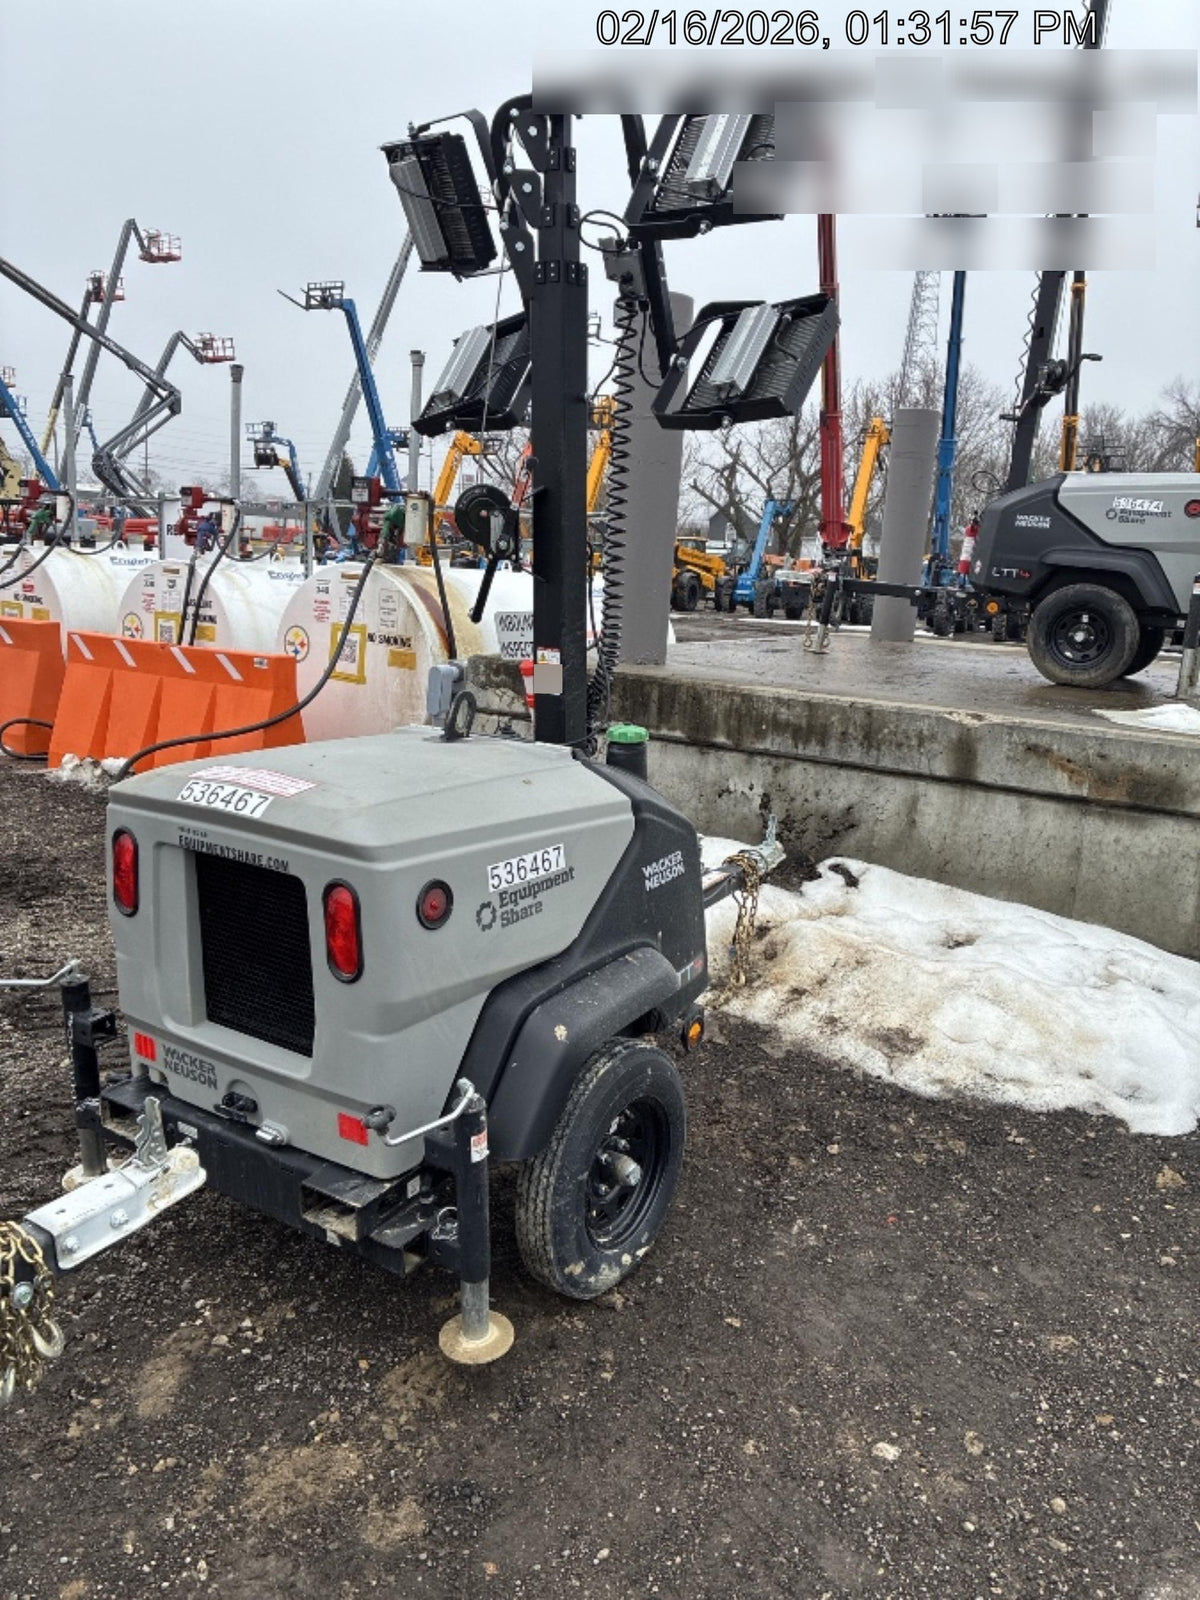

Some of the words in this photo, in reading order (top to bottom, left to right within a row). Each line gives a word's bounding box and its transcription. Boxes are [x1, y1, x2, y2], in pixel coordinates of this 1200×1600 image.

[992, 566, 1031, 579] LTT4
[180, 780, 270, 816] 536467
[178, 834, 290, 873] EQUIPMENTSHARE.COM
[490, 846, 562, 890] 536467
[641, 850, 684, 877] WACKER
[498, 865, 576, 910] Equipment
[645, 863, 686, 892] NEUSON
[501, 900, 544, 929] Share
[162, 1043, 217, 1077] WACKER
[164, 1057, 218, 1091] NEUSON
